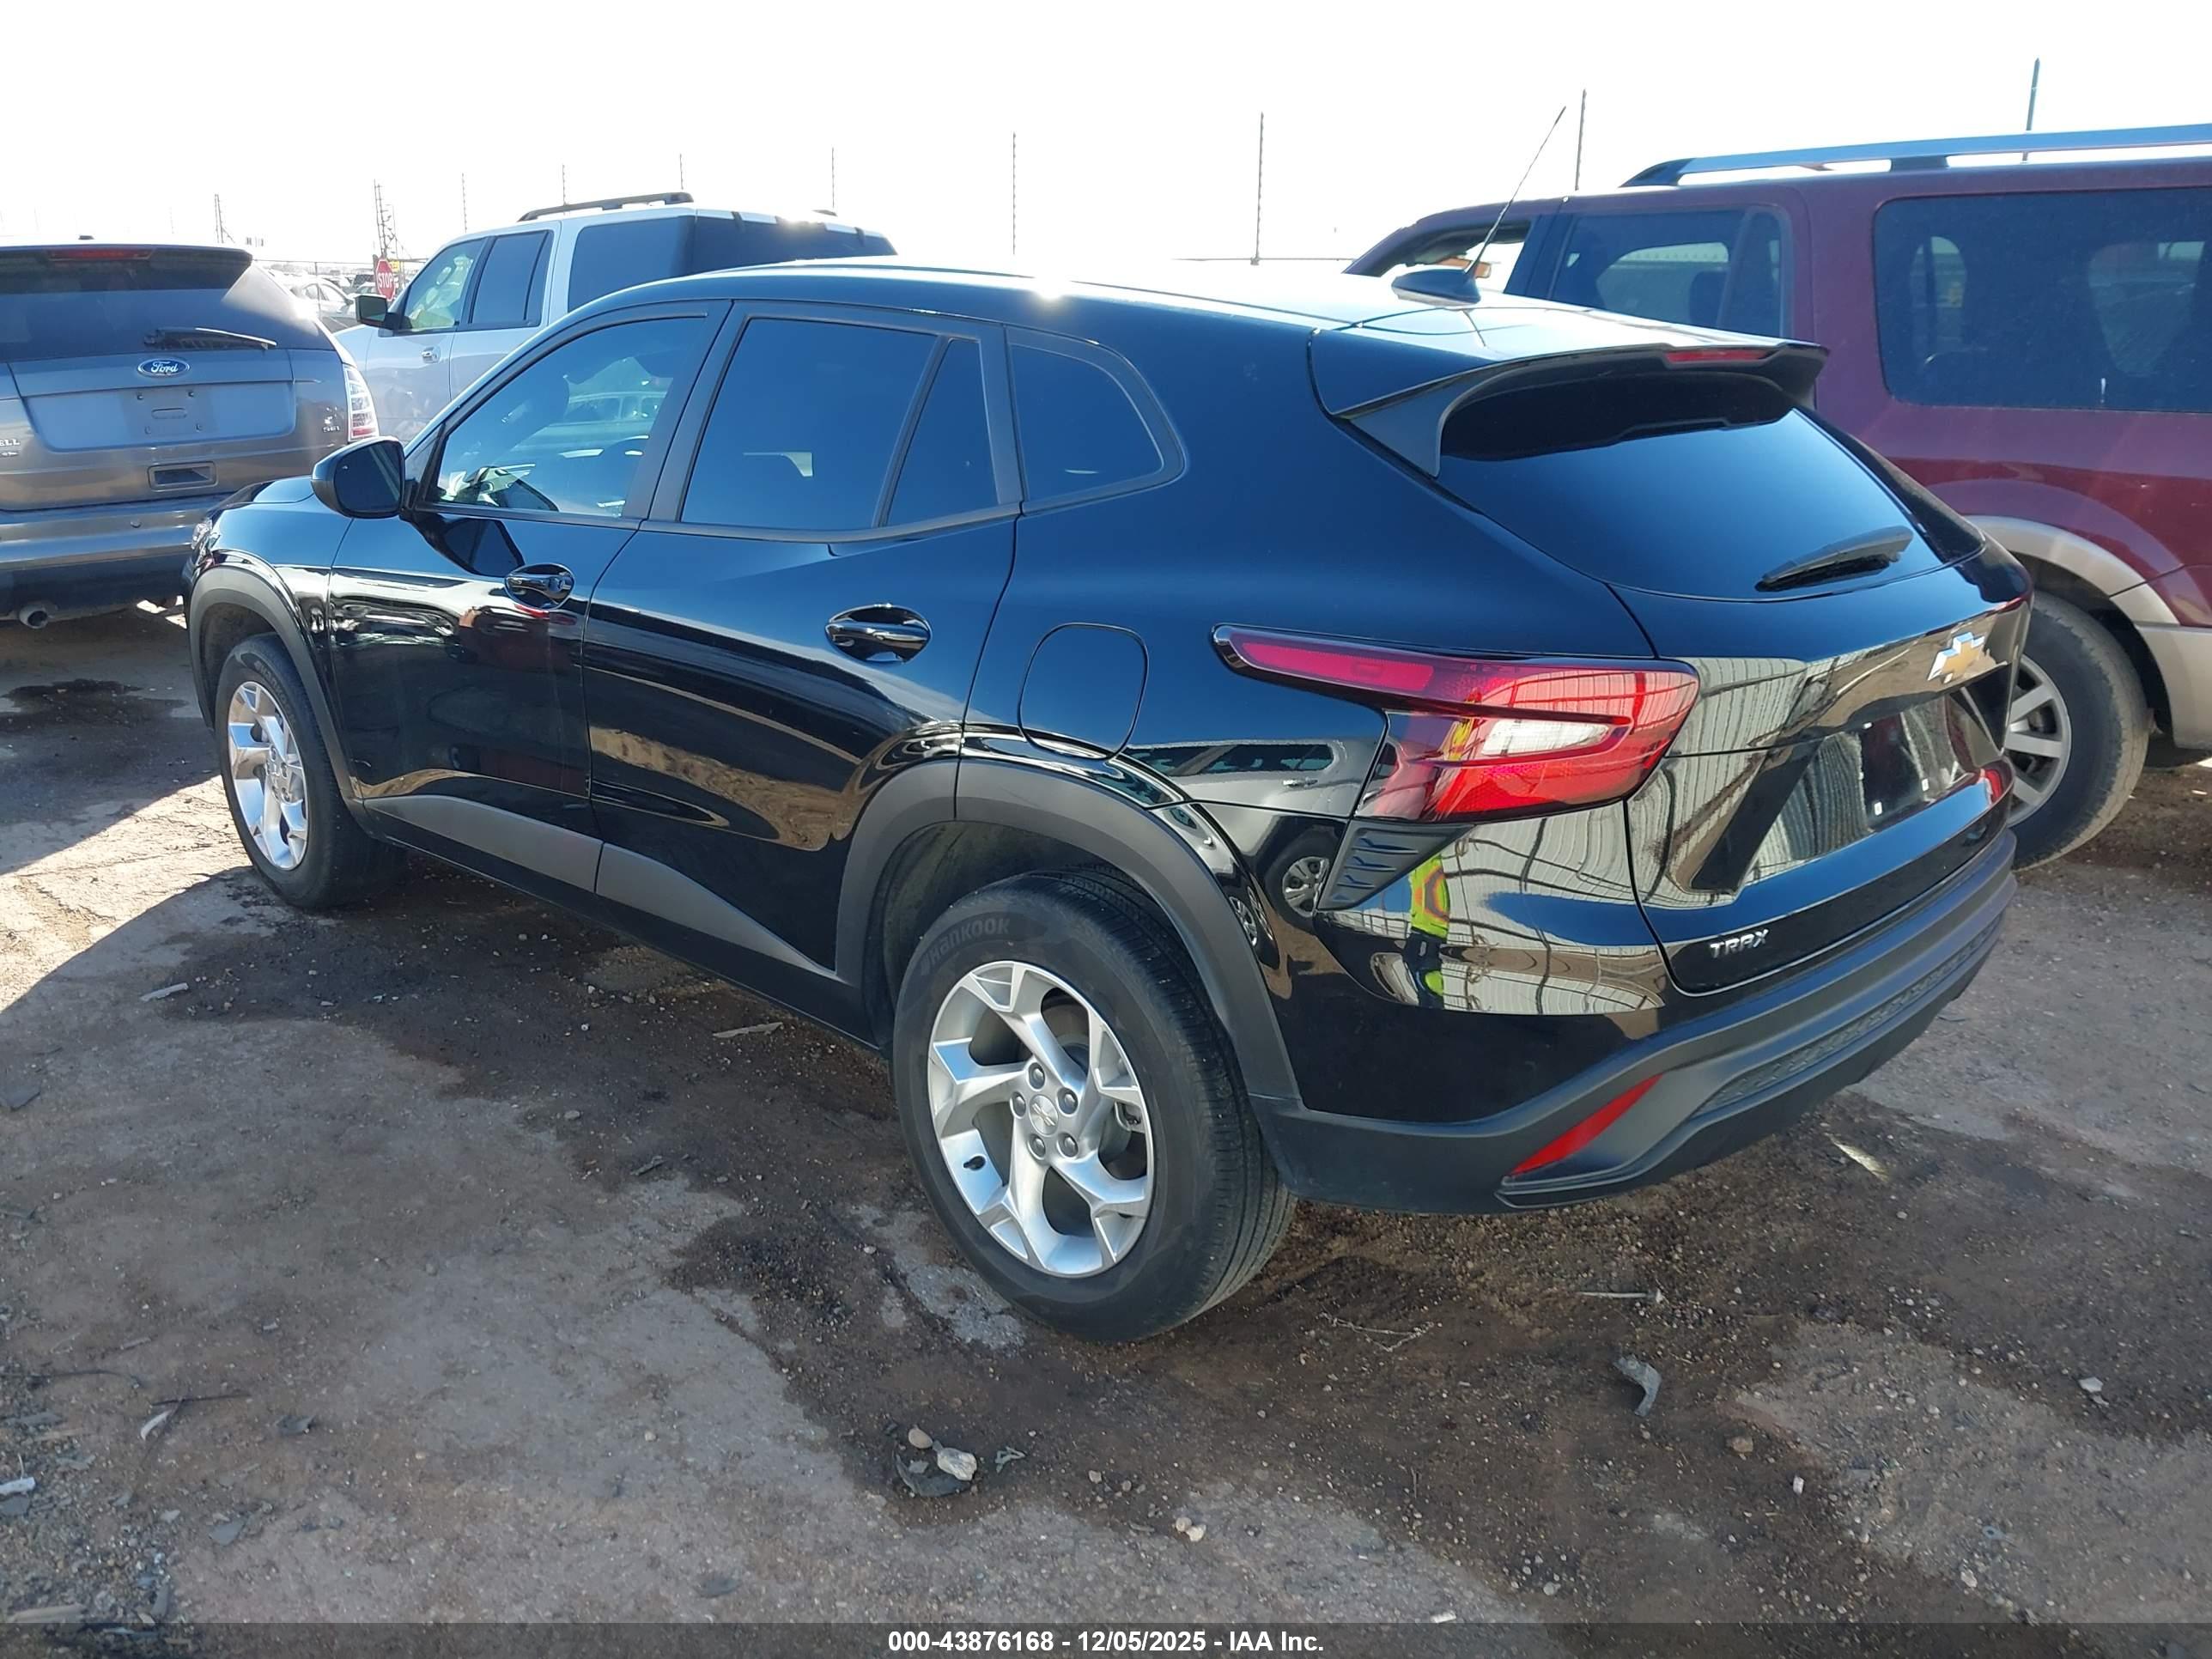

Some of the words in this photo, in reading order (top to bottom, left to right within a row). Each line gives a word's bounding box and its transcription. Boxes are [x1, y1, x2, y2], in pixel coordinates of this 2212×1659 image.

[378, 272, 393, 289] STOP
[150, 361, 179, 374] Ford
[1710, 928, 1770, 959] TRAX
